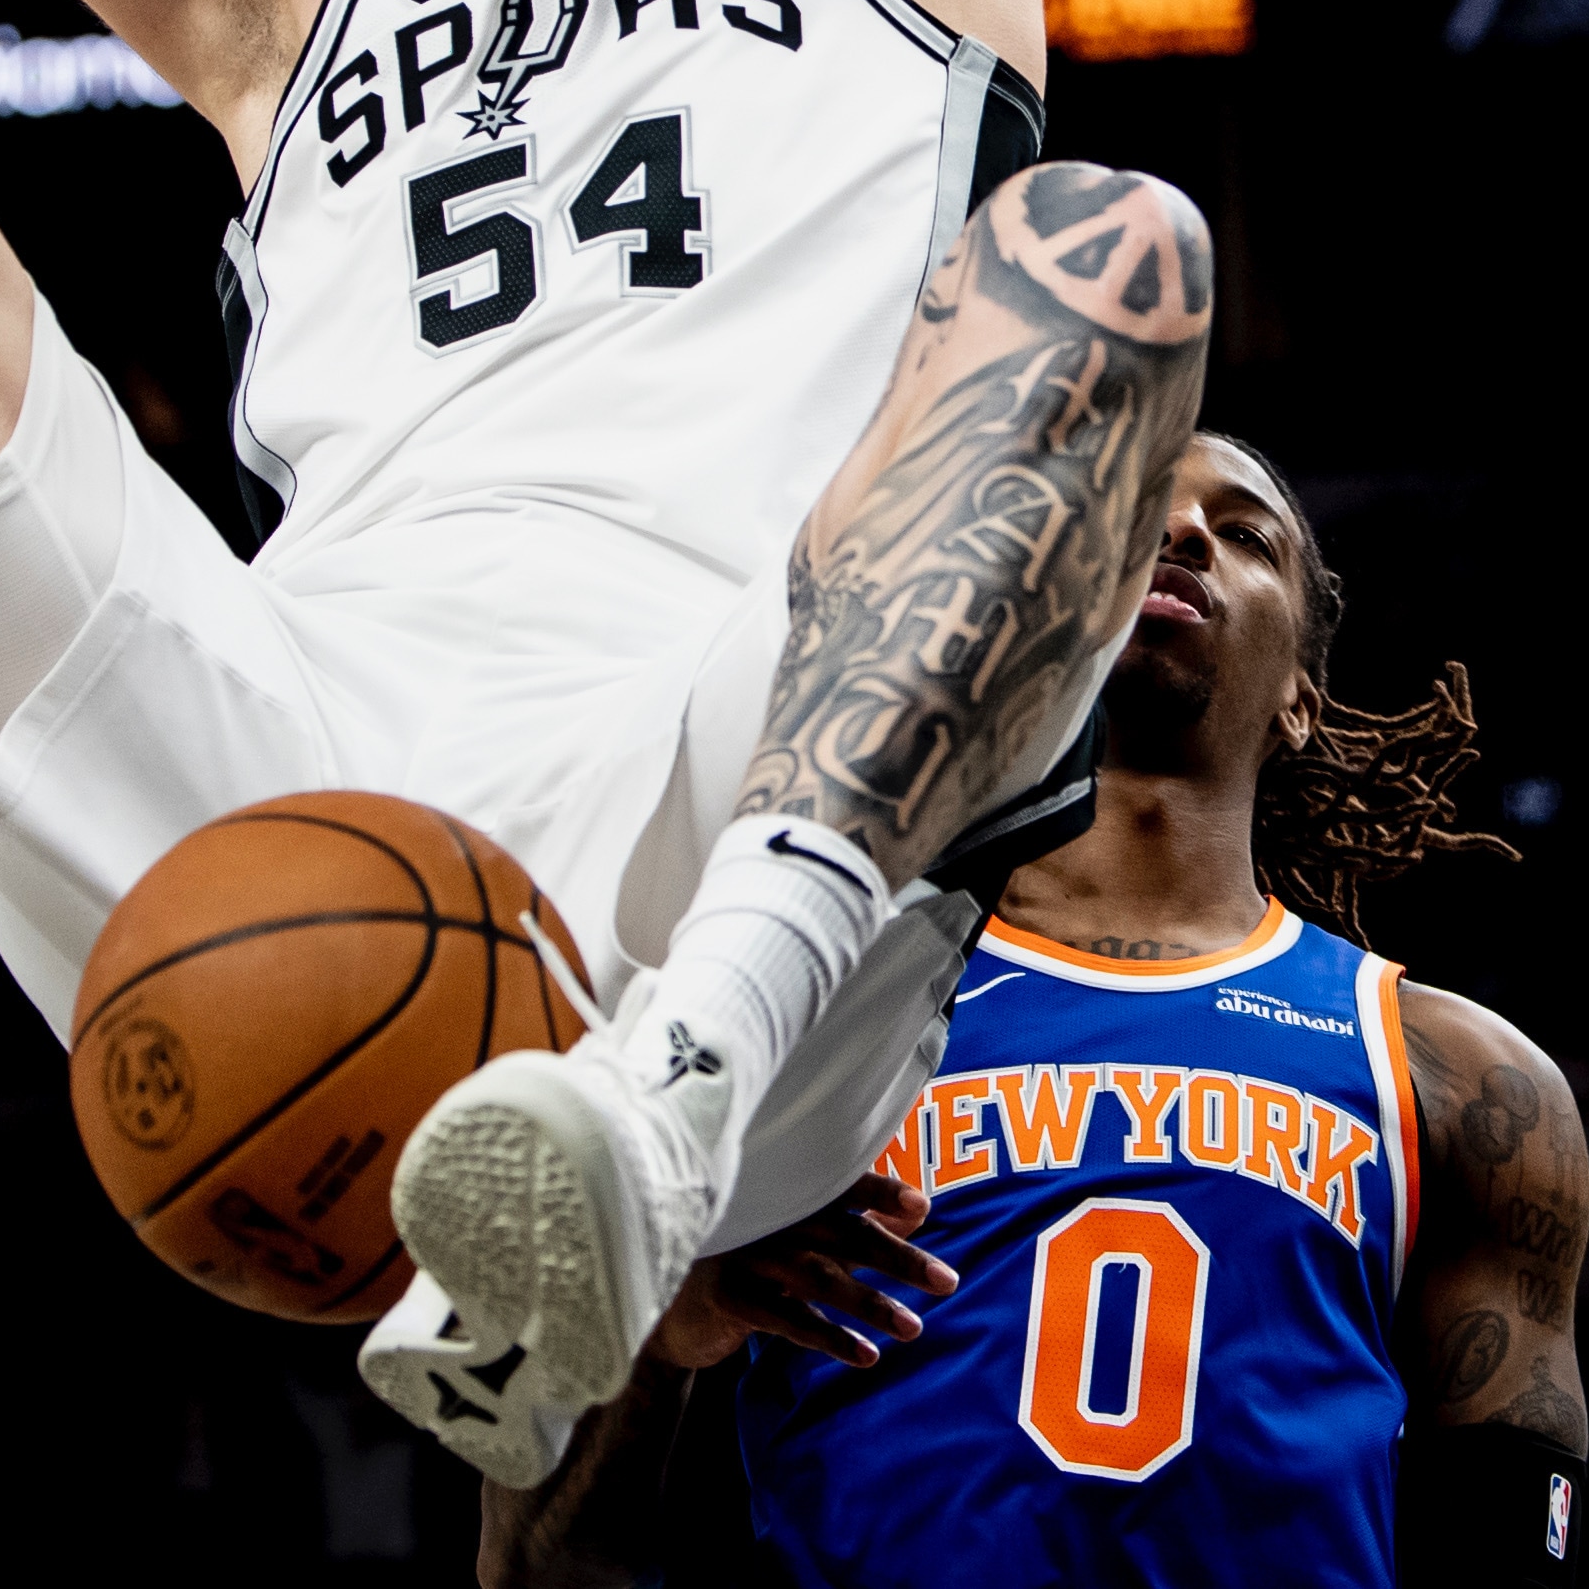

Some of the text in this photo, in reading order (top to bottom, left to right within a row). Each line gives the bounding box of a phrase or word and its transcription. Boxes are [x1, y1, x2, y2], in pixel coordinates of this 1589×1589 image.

[401, 105, 711, 359] 54
[1215, 996, 1356, 1037] abu dhabi
[1217, 986, 1292, 1010] experience
[1107, 1062, 1379, 1252] YORK
[1017, 1197, 1210, 1482] 0
